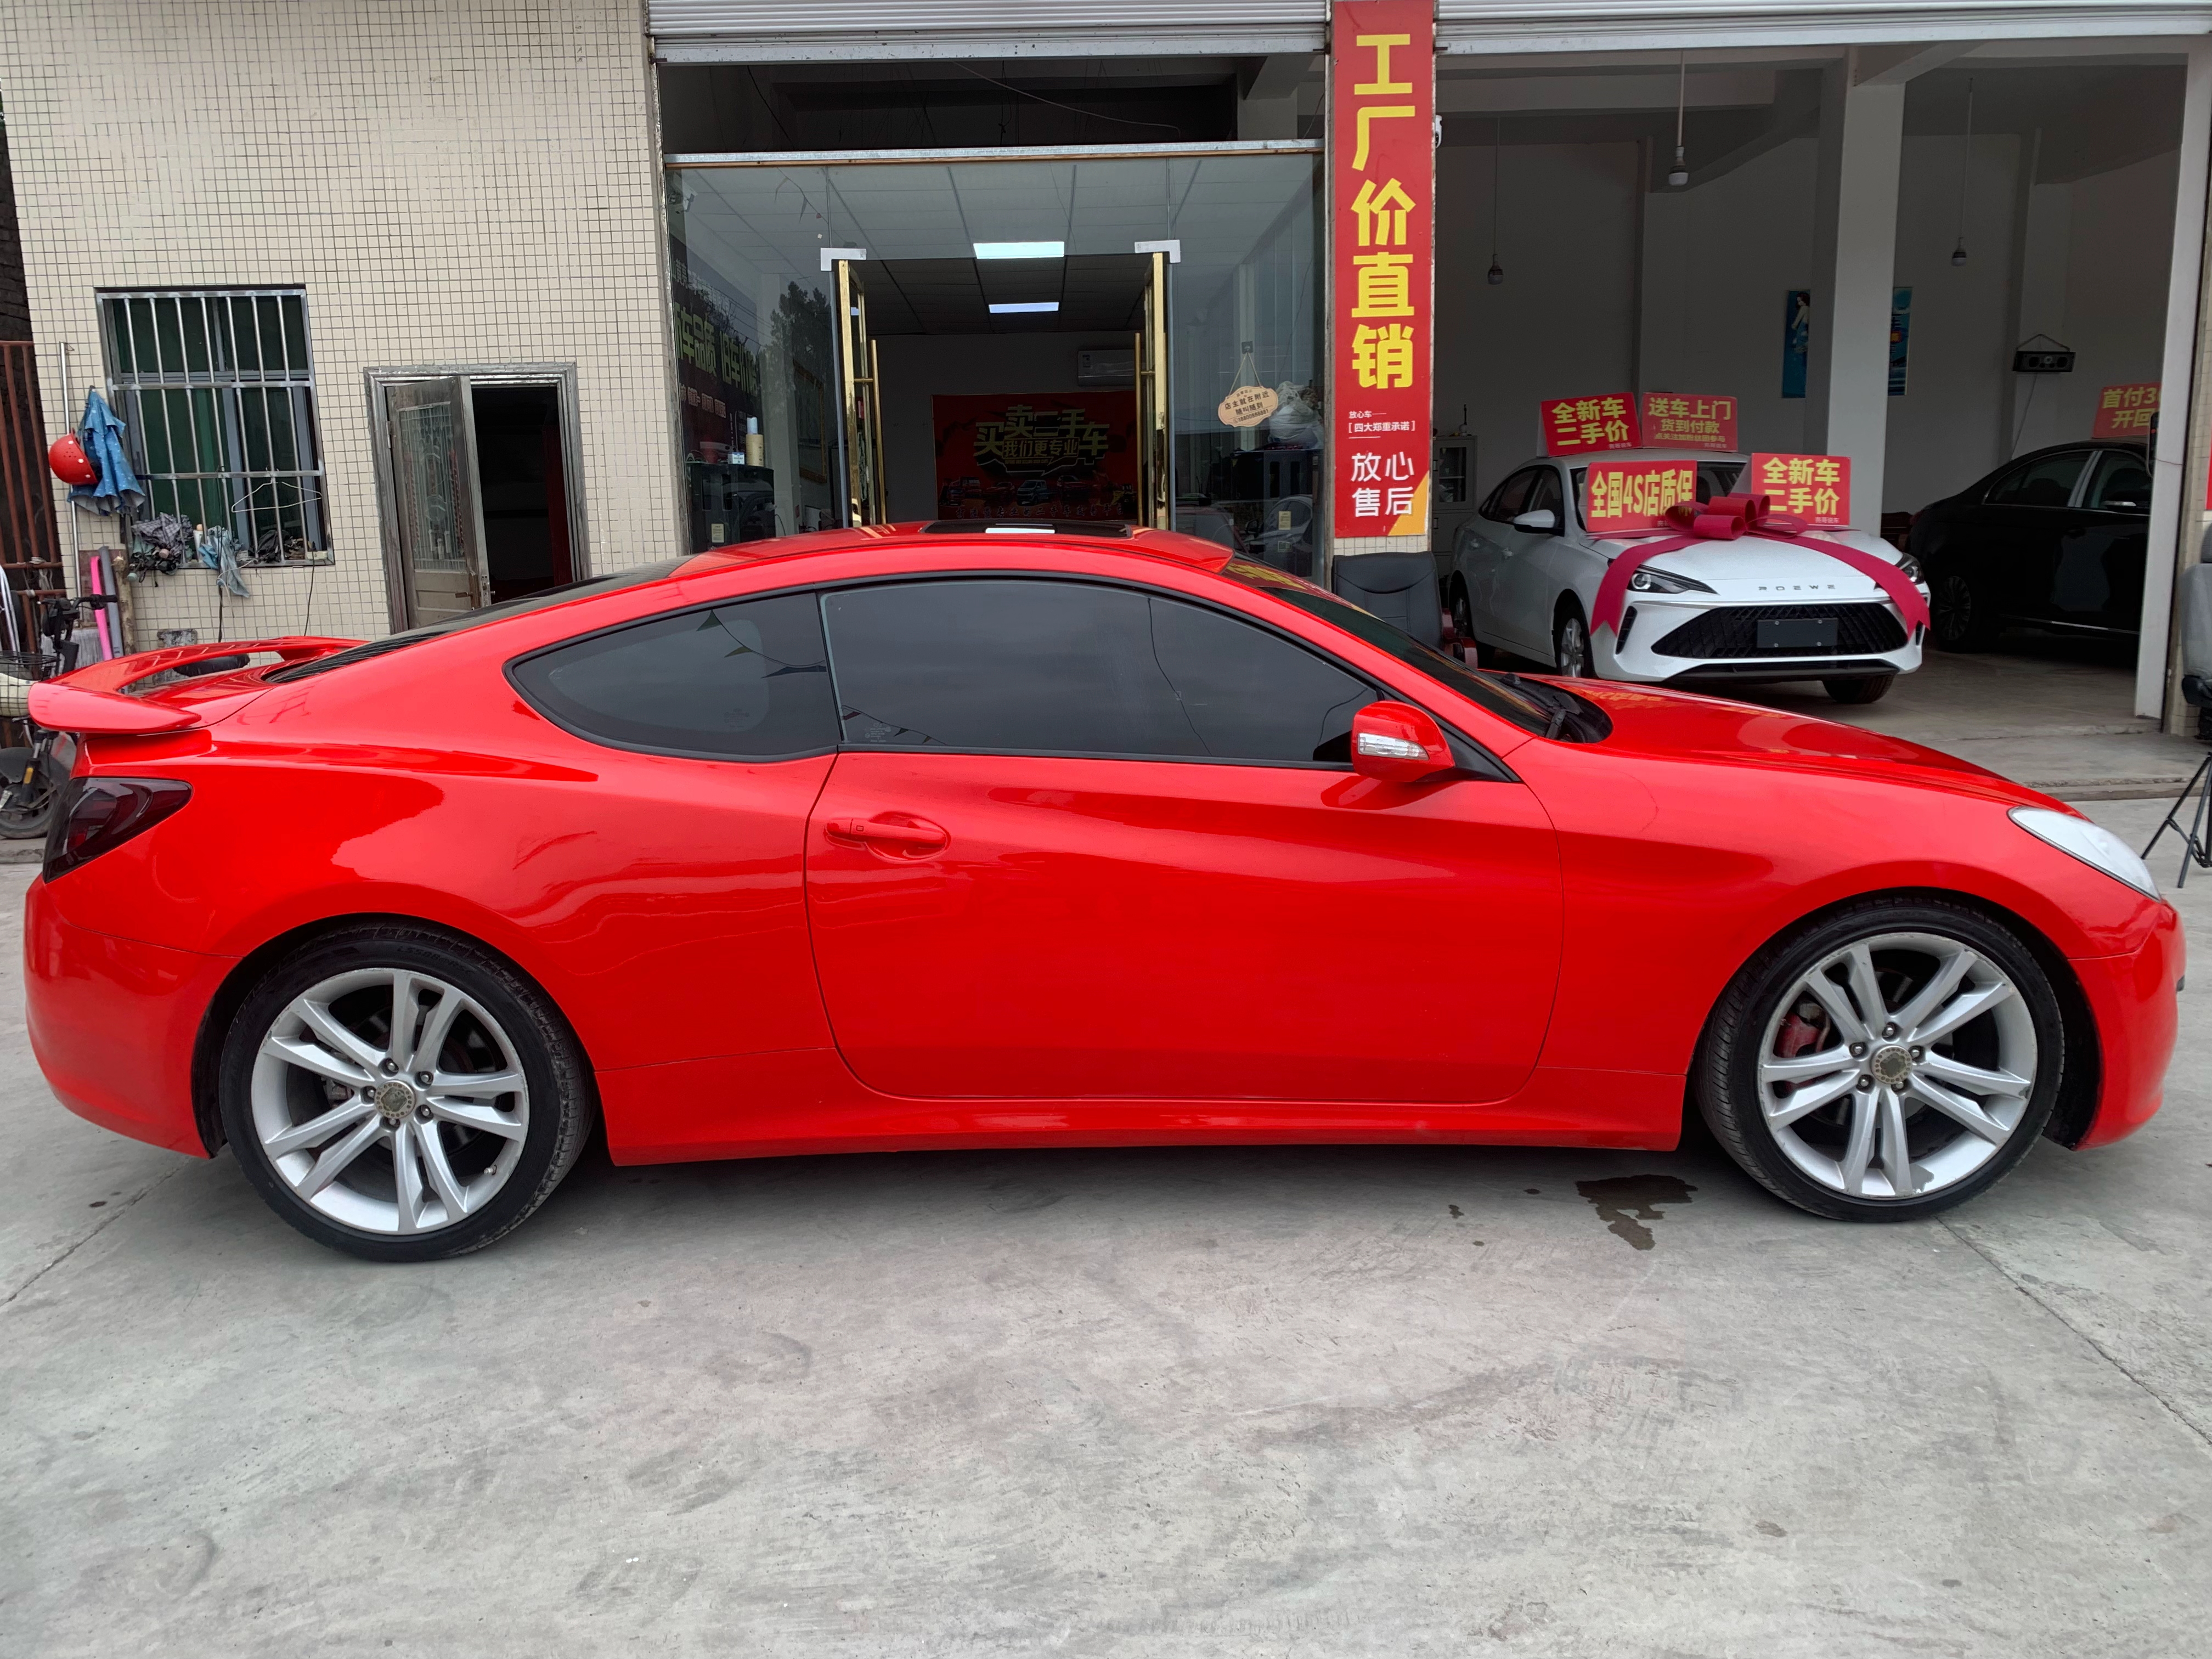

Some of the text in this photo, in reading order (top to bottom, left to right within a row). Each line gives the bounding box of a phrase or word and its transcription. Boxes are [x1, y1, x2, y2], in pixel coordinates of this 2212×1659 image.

[1351, 33, 1415, 389] 工厂价直销
[1225, 391, 1269, 410] 店主就在附近
[1552, 397, 1627, 424] 全新车
[1649, 397, 1731, 420] 送车上门
[2102, 386, 2161, 409] 首付3
[973, 404, 1110, 458] 买卖二手车
[1556, 420, 1629, 446] 二手价
[1661, 419, 1720, 434] 货到付款
[1003, 439, 1079, 458] 我们更专业
[1351, 452, 1415, 482] 放心
[1762, 457, 1841, 486] 全新车
[1351, 486, 1414, 517] 售后
[1591, 469, 1693, 518] 全国4S店质保
[1763, 488, 1840, 515] 二手价
